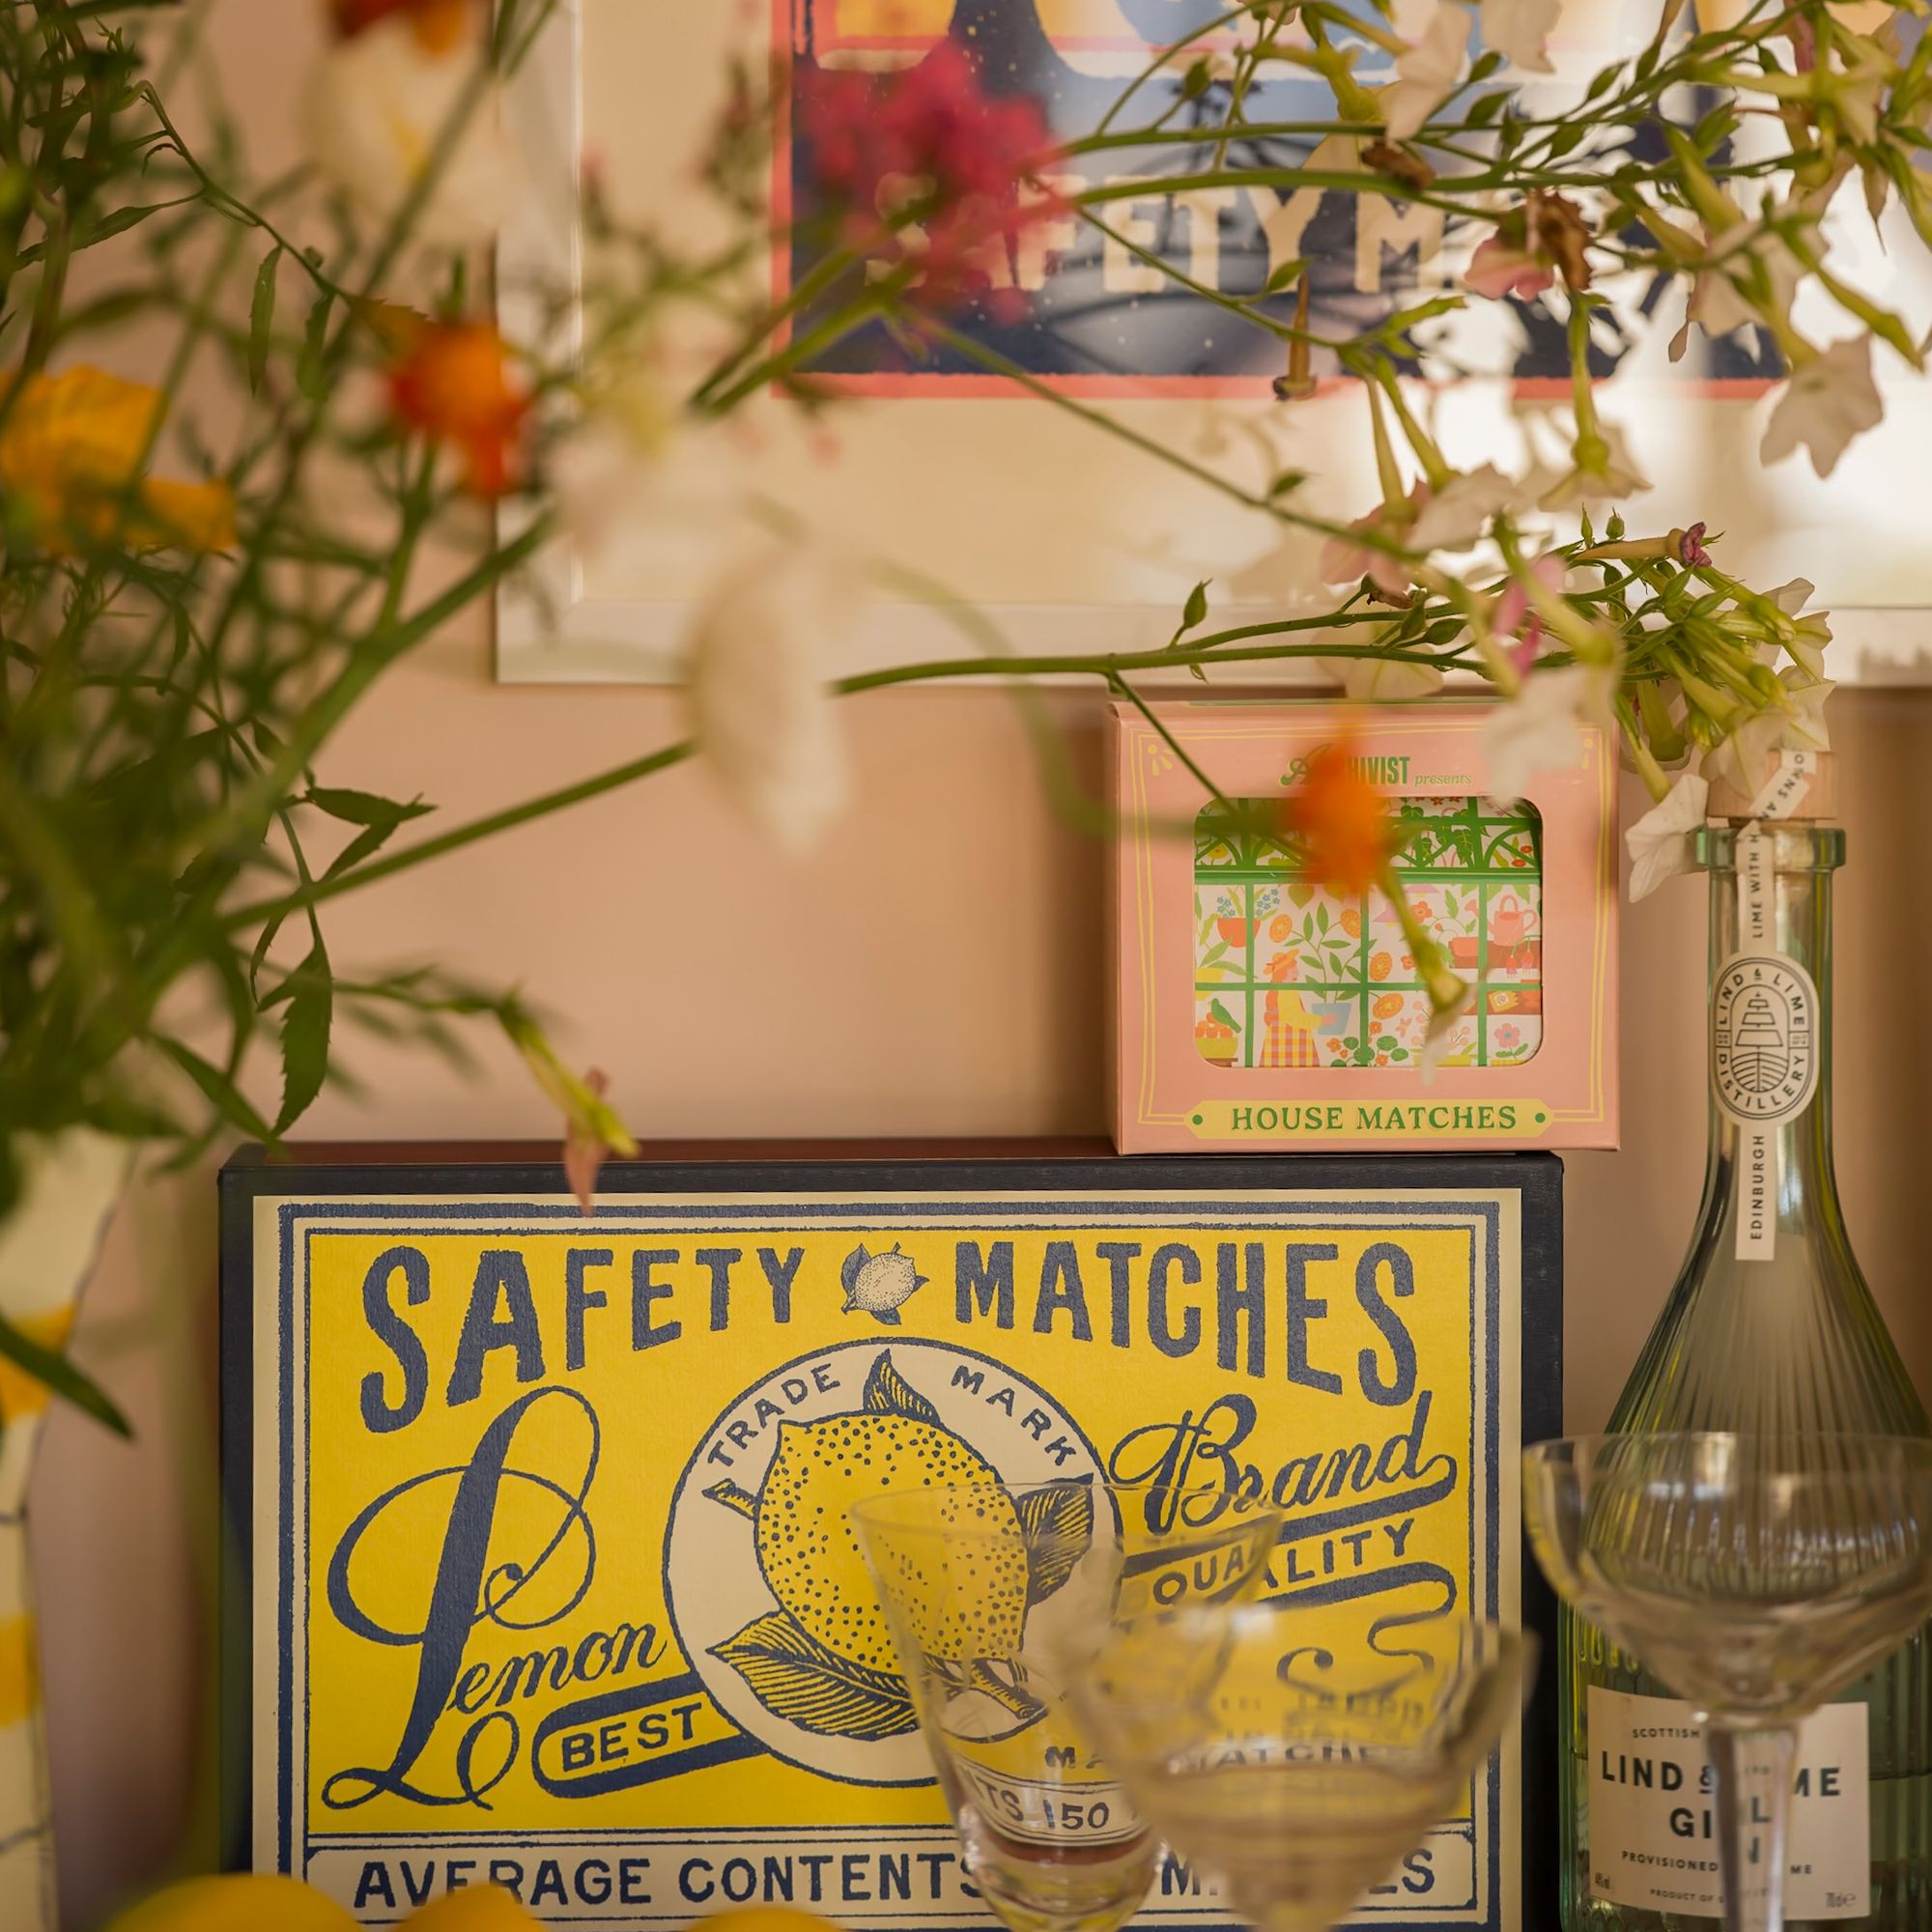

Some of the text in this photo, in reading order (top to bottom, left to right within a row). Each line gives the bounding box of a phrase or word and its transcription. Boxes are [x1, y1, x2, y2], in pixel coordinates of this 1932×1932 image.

[866, 171, 1326, 293] SFETY
[1414, 772, 1471, 787] presents
[1748, 852, 1761, 894] WITH
[1751, 900, 1763, 939] LIME
[1719, 973, 1744, 1026] LIND
[1773, 972, 1805, 1026] LIME
[1719, 1052, 1805, 1110] DISTILLERY
[1231, 1105, 1517, 1130] HOUSE MATCHES
[1749, 1135, 1765, 1240] EDINBURGH
[359, 1240, 1416, 1434] SAFETY MATCHES
[707, 1362, 1077, 1467] TRADE MARK
[1108, 1389, 1458, 1537] Brand
[321, 1384, 668, 1810] Lemon
[557, 1700, 703, 1773] BEST
[1632, 1726, 1701, 1739] SCOTTISH
[1601, 1750, 1684, 1791] LIND
[354, 1858, 652, 1908] AVERAGE
[1622, 1850, 1719, 1872] PROVISIONED
[1649, 1888, 1696, 1901] PRODUCT
